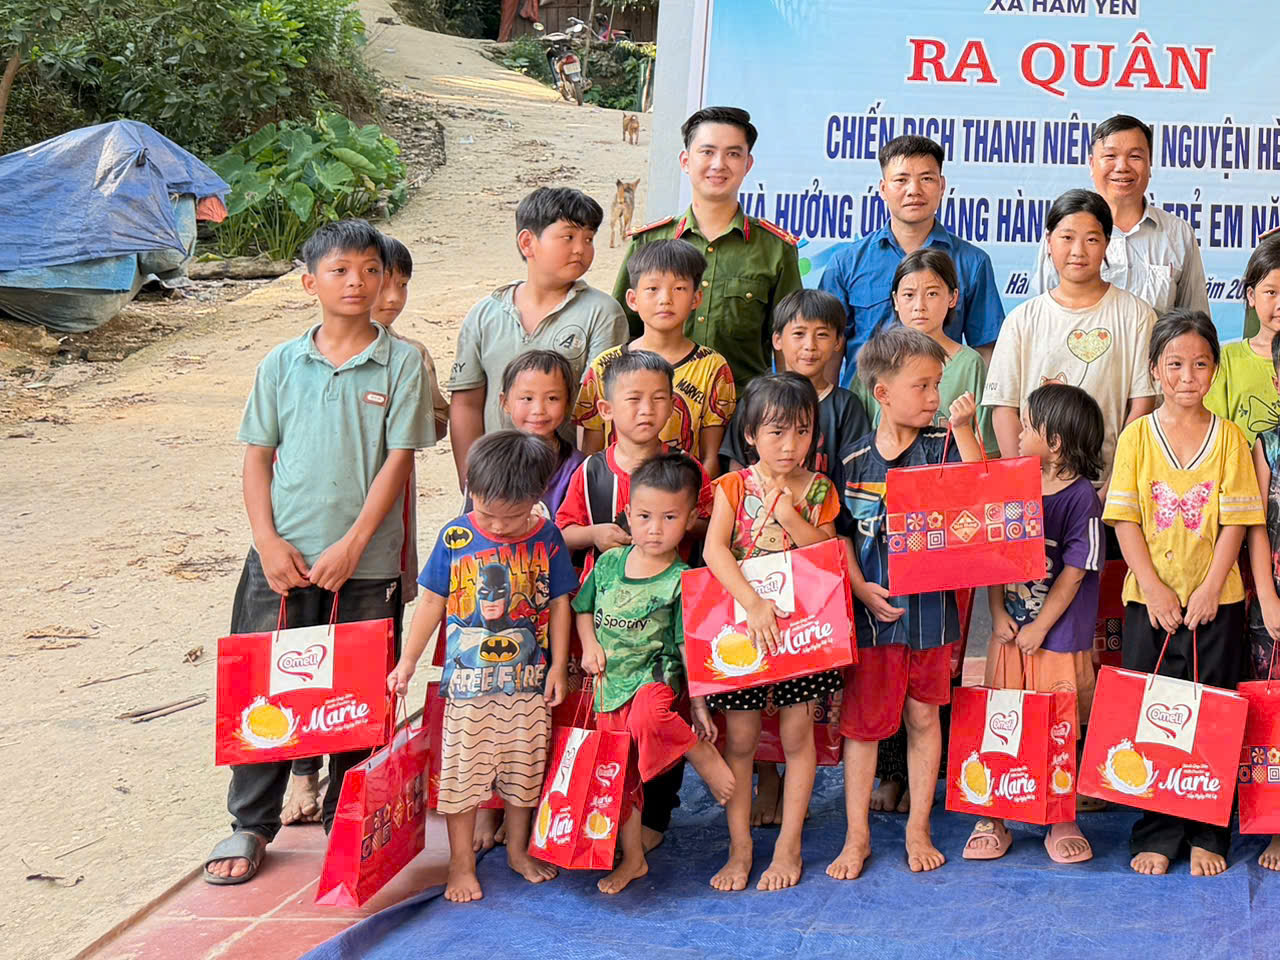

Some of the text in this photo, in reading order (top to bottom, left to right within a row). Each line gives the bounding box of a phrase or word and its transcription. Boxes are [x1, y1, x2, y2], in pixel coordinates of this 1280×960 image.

[907, 31, 1213, 97] RA QUÂN
[826, 101, 895, 159] CHIẾN
[962, 118, 1036, 164] THANH
[1161, 117, 1250, 179] NGUYỆN
[775, 178, 853, 239] HƯỞNG
[1208, 204, 1243, 248] EM
[773, 621, 834, 656] Marie
[451, 662, 547, 693] FREE FIRE
[302, 699, 371, 733] Marie
[995, 773, 1037, 800] Marie
[1158, 767, 1222, 797] Marie
